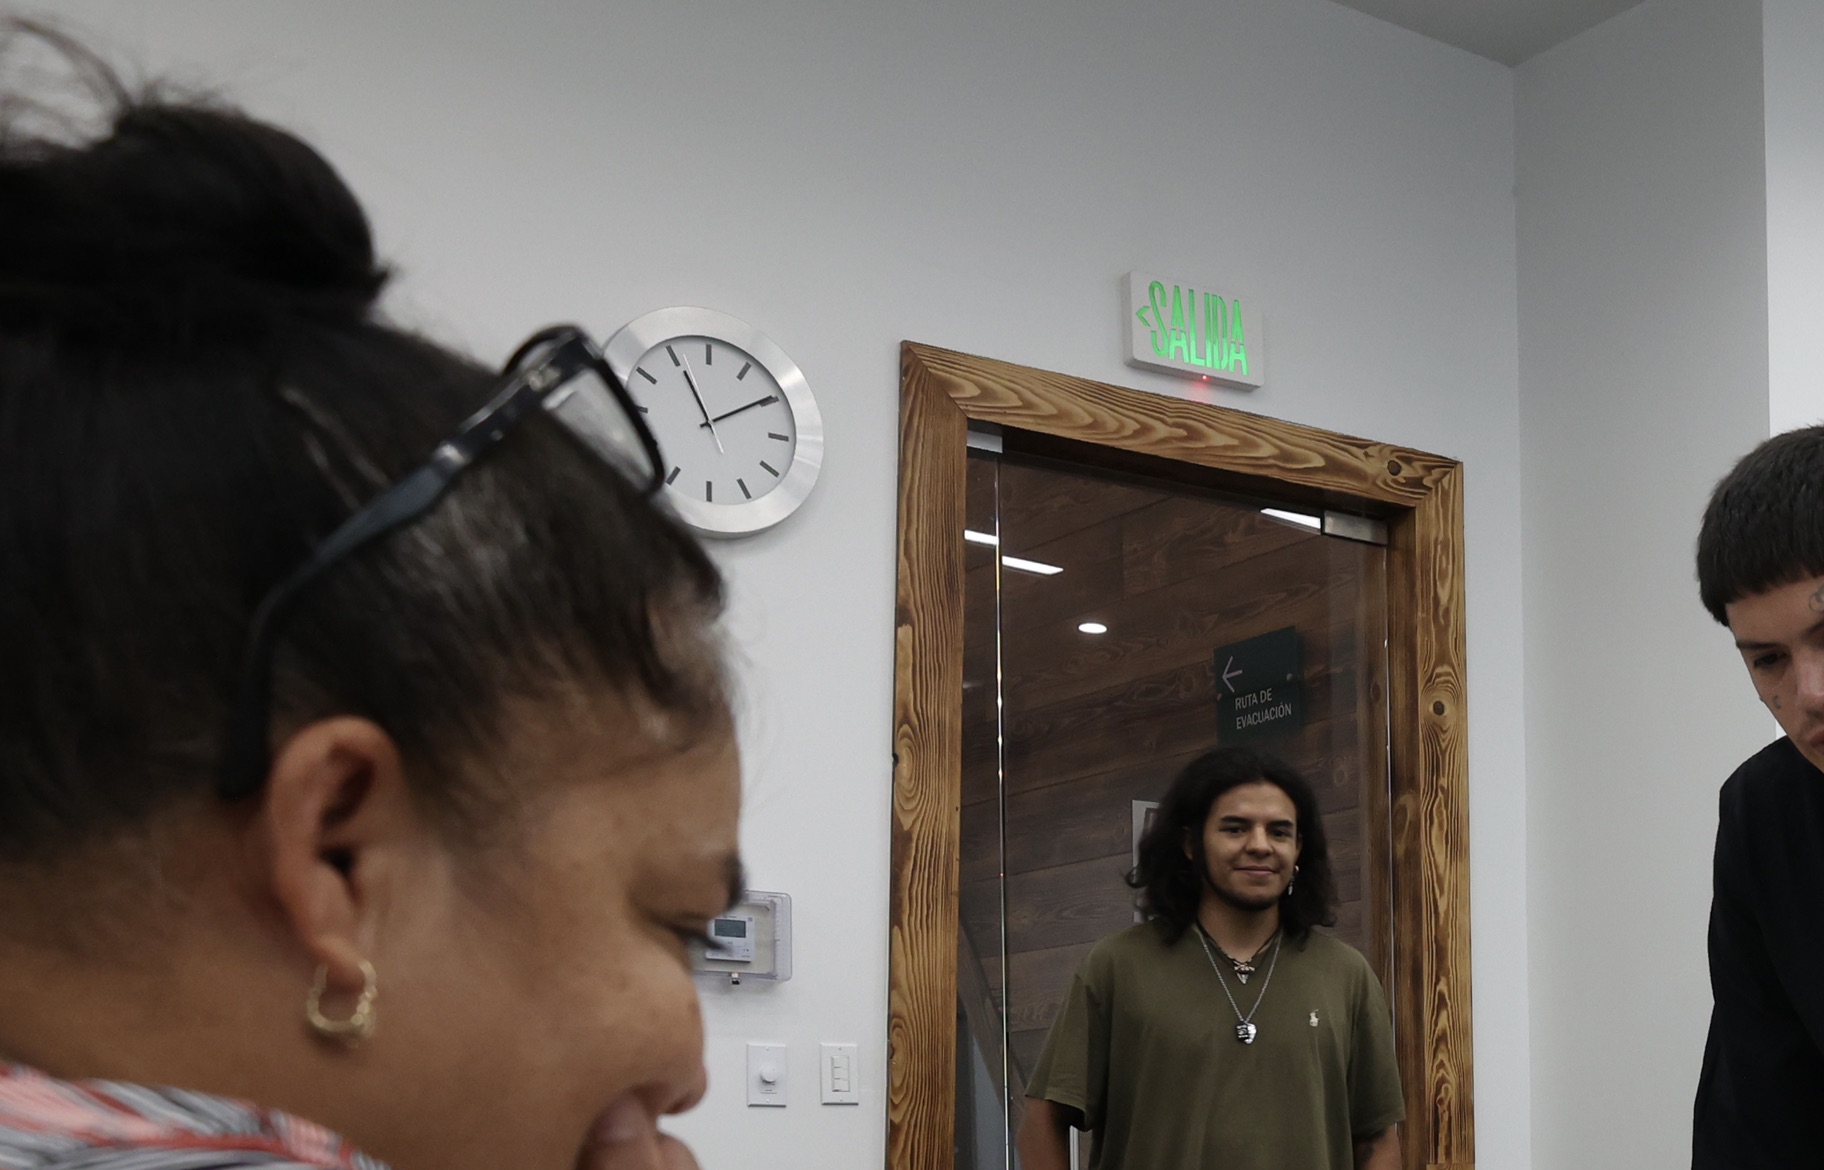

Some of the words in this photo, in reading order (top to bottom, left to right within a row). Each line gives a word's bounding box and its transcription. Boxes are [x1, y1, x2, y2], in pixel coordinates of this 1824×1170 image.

[1149, 281, 1249, 375] SALIDA
[1235, 692, 1258, 710] RUTA
[1260, 688, 1272, 703] DE
[1236, 702, 1292, 730] EVACUACIÓN
